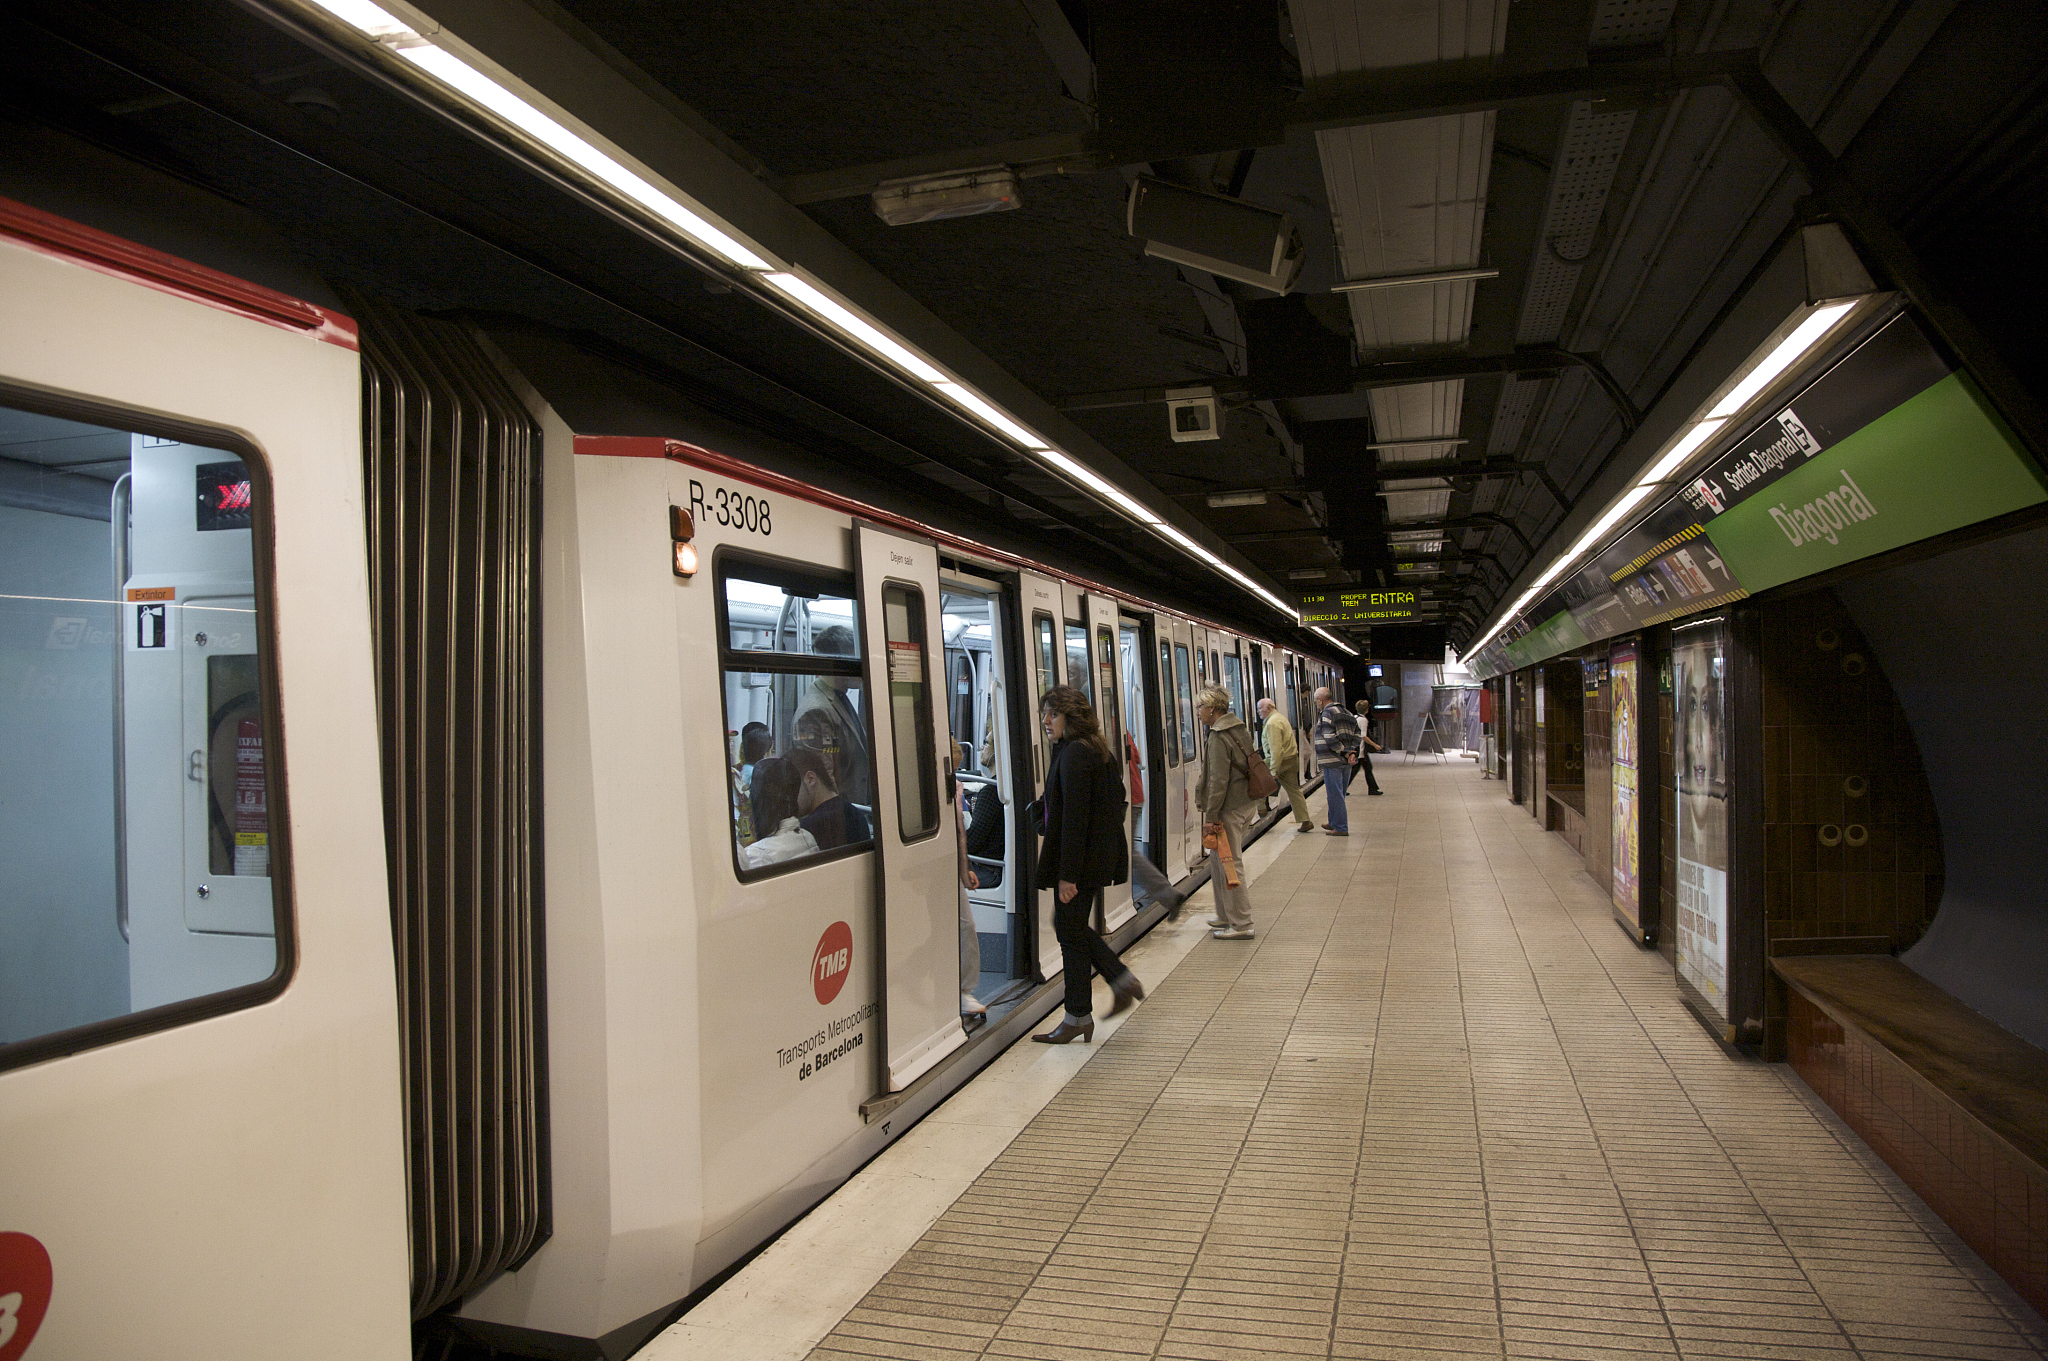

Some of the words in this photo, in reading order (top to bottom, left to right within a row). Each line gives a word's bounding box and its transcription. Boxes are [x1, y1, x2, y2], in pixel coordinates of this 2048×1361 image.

[1723, 459, 1761, 492] Sortida
[1748, 429, 1800, 470] Diagonal
[689, 478, 772, 536] R-3308
[1768, 469, 1878, 548] Diagonal
[890, 551, 904, 565] Dejen
[904, 555, 913, 566] salir
[135, 590, 167, 600] Extintor
[1341, 593, 1368, 601] PROPER
[1371, 591, 1415, 605] ENTRA
[819, 947, 848, 981] TMB
[777, 1029, 826, 1069] Transports
[799, 1061, 812, 1081] de
[815, 1032, 863, 1072] Barcelona
